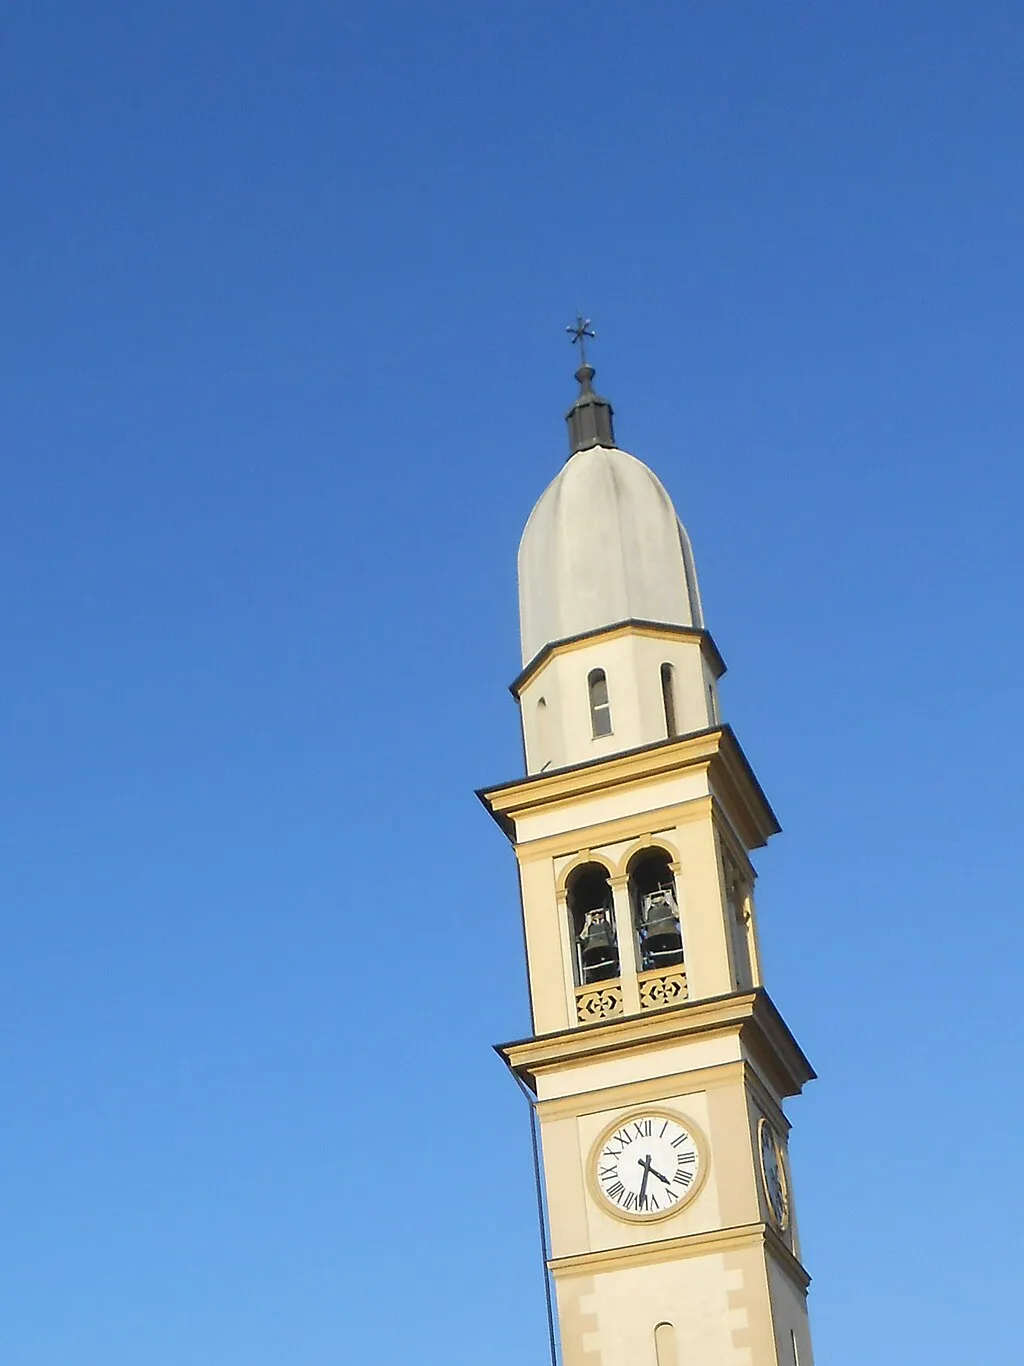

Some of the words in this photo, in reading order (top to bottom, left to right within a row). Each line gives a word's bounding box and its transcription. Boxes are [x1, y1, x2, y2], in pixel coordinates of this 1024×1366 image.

[634, 1120, 651, 1139] XII
[659, 1120, 668, 1138] I
[613, 1128, 633, 1150] XI
[670, 1133, 688, 1149] II
[603, 1146, 622, 1160] X
[677, 1151, 695, 1165] III
[600, 1164, 619, 1181] IX
[673, 1168, 693, 1187] IIII
[606, 1180, 626, 1204] VIII
[665, 1187, 679, 1203] V
